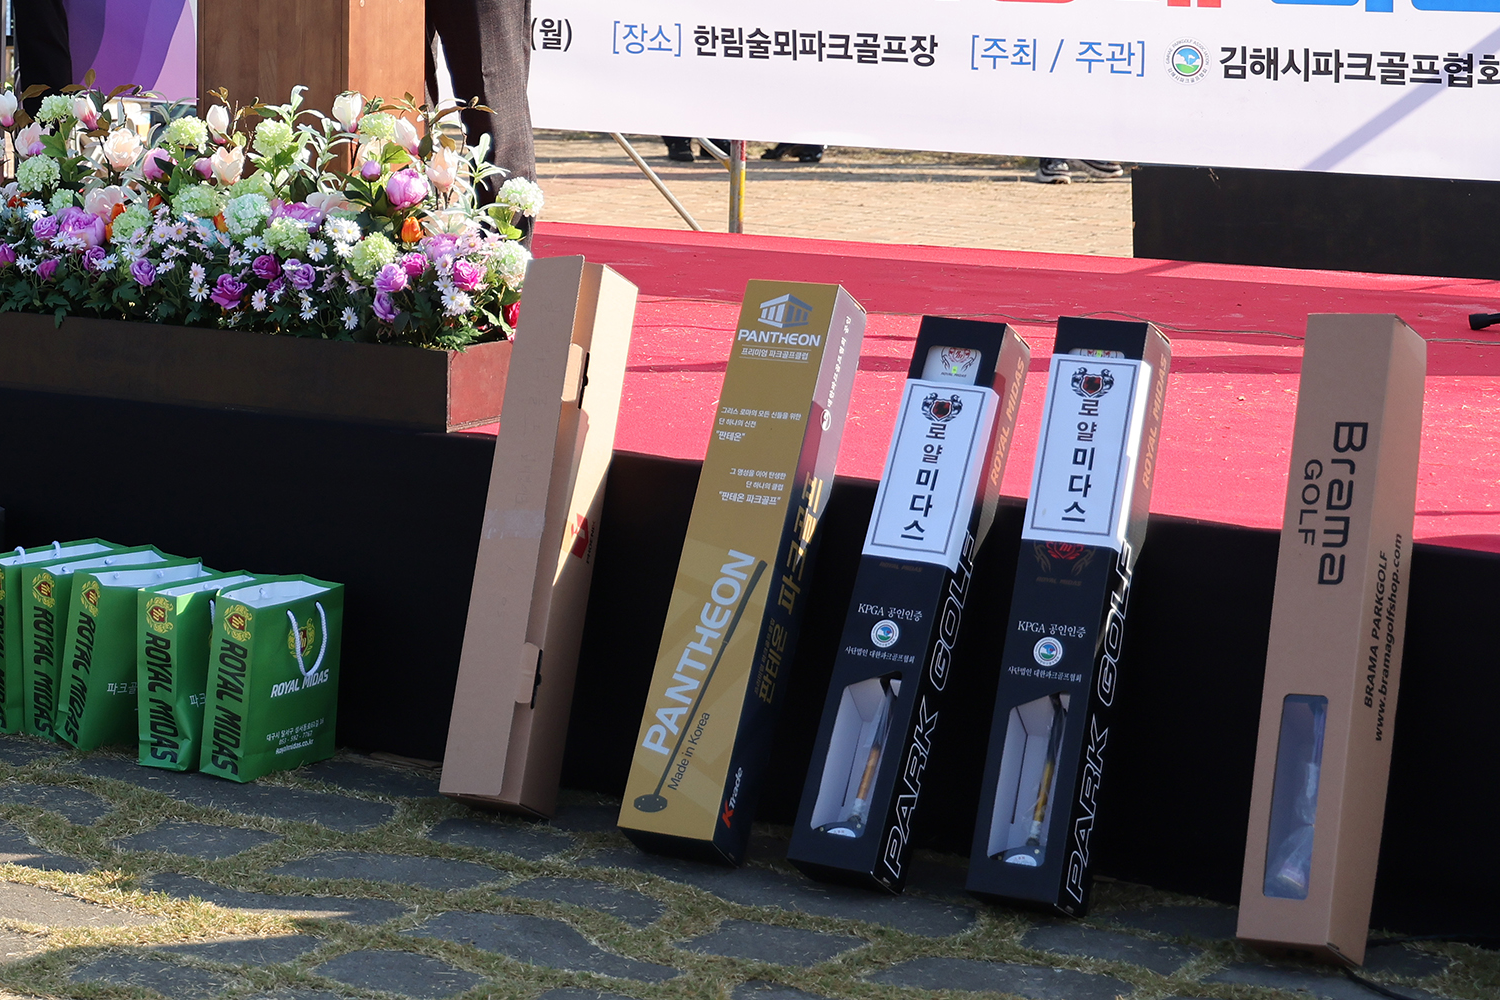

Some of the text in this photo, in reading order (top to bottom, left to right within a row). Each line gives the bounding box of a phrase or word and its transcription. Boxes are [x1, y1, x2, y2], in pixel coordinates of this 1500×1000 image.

[612, 20, 683, 57] [장소]
[694, 25, 938, 67] 한림술뫼파크골프장
[971, 35, 1037, 72] [주최
[1075, 41, 1146, 77] 주관]
[737, 329, 822, 347] PANTHEON
[741, 347, 809, 361] 프리미엄 파크골프클럽
[900, 422, 947, 541] 로얄미다스
[990, 356, 1025, 487] ROYAL MIDAS
[1061, 399, 1100, 523] 로얄미다스
[1141, 356, 1168, 490] ROYAL MIDAS
[1298, 459, 1323, 545] GOLF
[1317, 421, 1369, 585] Brama
[642, 549, 756, 755] PANTHEON
[758, 471, 824, 704] 판테온 파크골프
[858, 603, 923, 622] KPGA 공인인증
[1017, 620, 1086, 638] KPGA 공인인증
[1364, 550, 1387, 709] BRAMA PARKGOLF
[1375, 533, 1402, 743] www.bramagolfshop.com
[33, 606, 54, 738] ROYAL MIDAS
[64, 611, 96, 744] ROYAL MIDAS
[145, 632, 180, 763] ROYAL MIDAS
[211, 638, 248, 776] ROYAL MIDAS
[271, 669, 330, 698] ROYAL MIDAS
[883, 695, 939, 879] PARK
[929, 530, 975, 691] GOLF
[1065, 538, 1134, 903] PARK GOLF
[668, 712, 710, 791] Made in Korea
